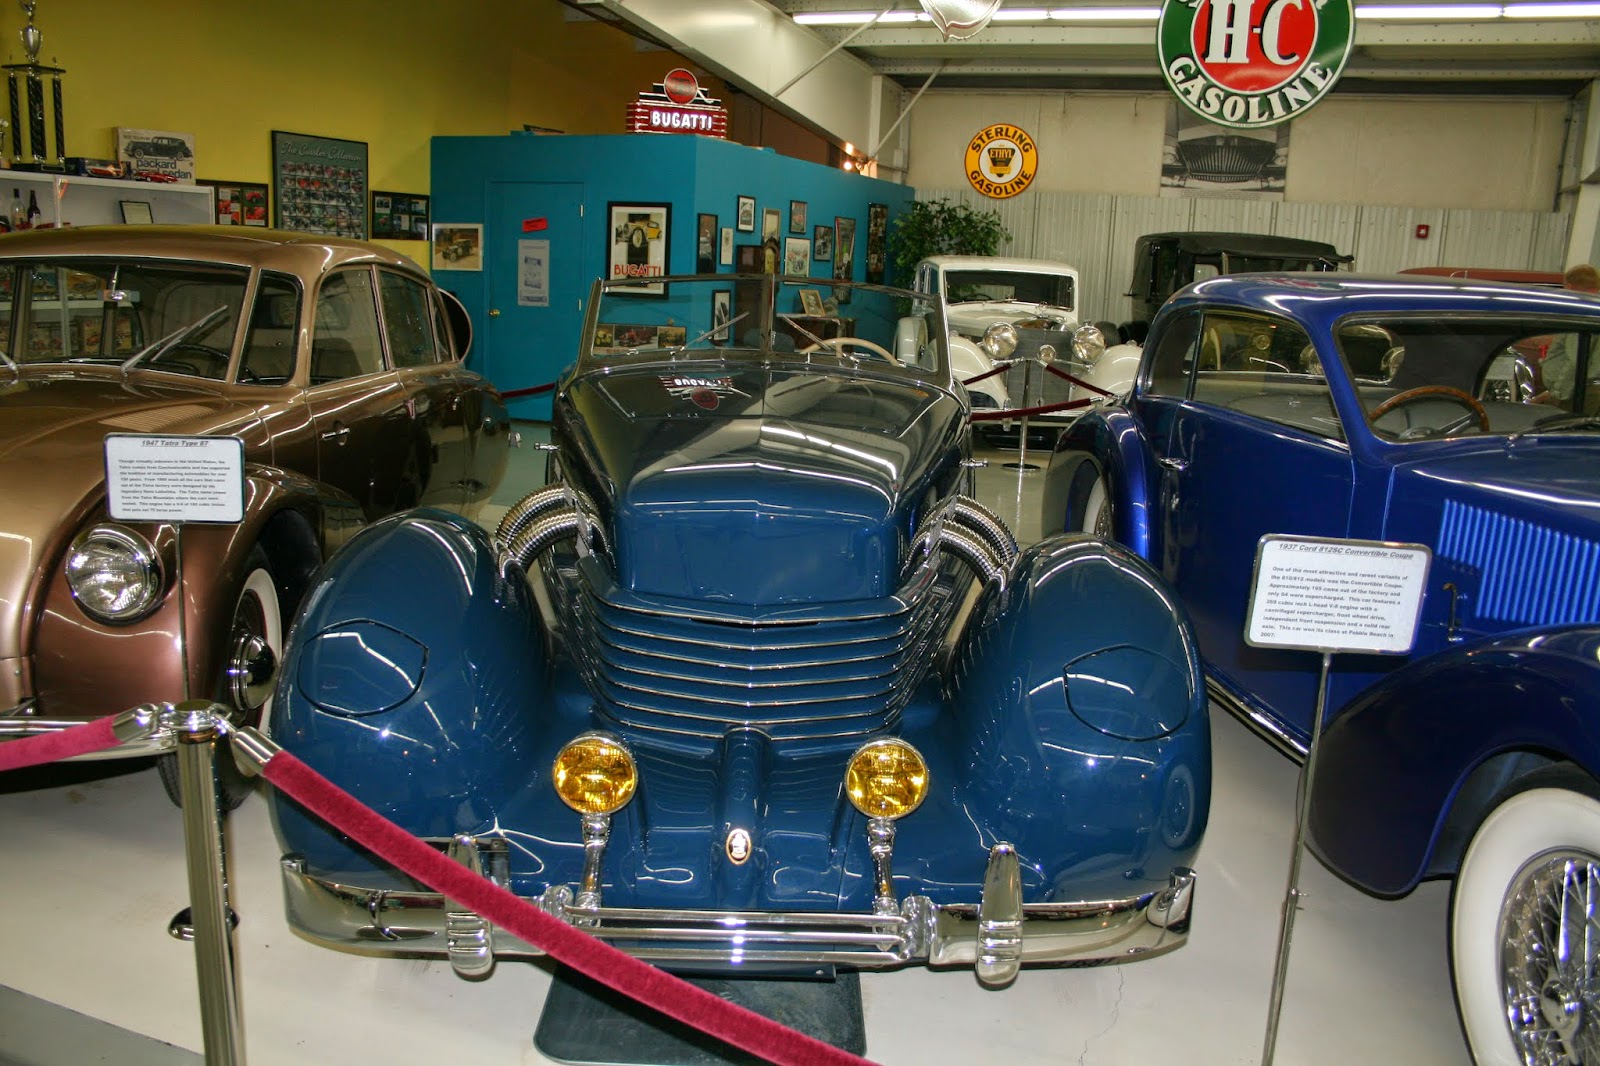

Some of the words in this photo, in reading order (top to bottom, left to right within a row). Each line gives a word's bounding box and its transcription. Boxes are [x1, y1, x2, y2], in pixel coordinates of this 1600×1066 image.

[1203, 0, 1303, 66] H-C
[1169, 57, 1333, 122] GASOLINE
[652, 111, 712, 129] BUGATTI
[280, 140, 297, 154] The
[972, 126, 1032, 153] STERLING
[990, 148, 1013, 158] ETHYL
[137, 158, 176, 169] packard
[970, 170, 1032, 196] GASOLINE
[614, 264, 661, 277] BUGATTI
[1345, 548, 1388, 558] Convertible
[1390, 552, 1414, 560] Coupe
